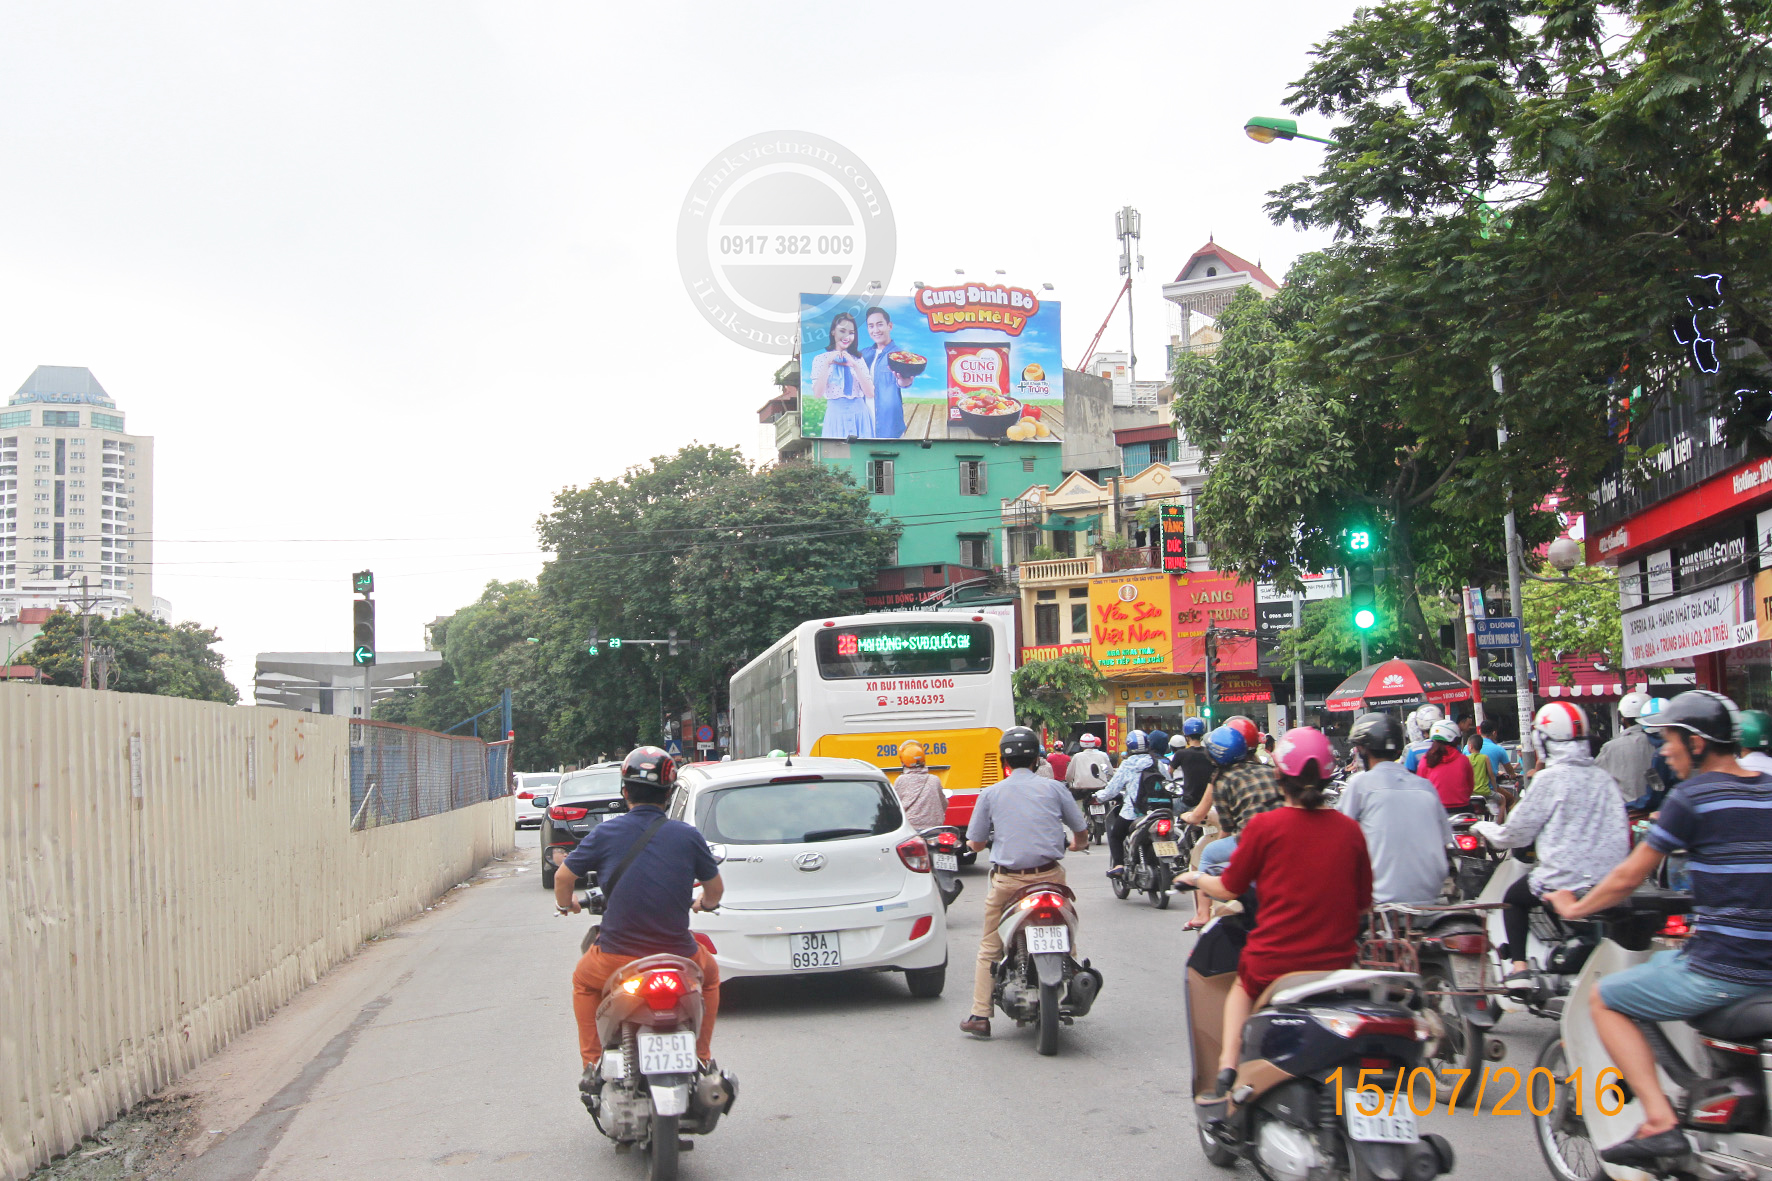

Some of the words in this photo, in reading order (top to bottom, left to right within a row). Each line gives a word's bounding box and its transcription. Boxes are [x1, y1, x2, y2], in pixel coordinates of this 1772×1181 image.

[922, 289, 966, 307] Cung
[967, 286, 1008, 305] Đình
[1011, 290, 1033, 309] Bò
[978, 310, 1001, 323] Mê
[960, 360, 994, 371] CUNG
[1674, 431, 1692, 470] kiện
[1733, 468, 1759, 494] Hotline:
[1163, 518, 1184, 533] VÀNG
[1351, 532, 1369, 550] 23
[1164, 557, 1187, 569] TRUNG
[1680, 548, 1713, 576] SAMSUNG
[1713, 537, 1745, 565] Galaxy
[1650, 562, 1671, 578] NOKIA
[895, 591, 915, 606] ĐỘNG
[1191, 587, 1233, 604] VÀNG
[1097, 600, 1128, 623] Yến
[1207, 607, 1249, 621] TRUNG
[1489, 621, 1516, 629] ĐƯỜNG
[1630, 620, 1647, 635] XPERIA
[1648, 616, 1655, 629] XA
[1659, 608, 1674, 627] HÀNG
[1094, 624, 1124, 645] Việt
[1128, 623, 1166, 643] Nam
[1495, 633, 1510, 645] PHONG
[1510, 631, 1519, 644] SẮC
[1691, 631, 1702, 647] LOA
[1704, 628, 1712, 643] 20
[1737, 625, 1753, 643] SONY
[609, 638, 621, 648] 23
[838, 635, 858, 655] 26
[858, 639, 875, 651] MAI
[1022, 648, 1058, 665] PHOTO
[866, 682, 878, 691] XN
[880, 681, 896, 691] BUS
[931, 678, 954, 689] LONG
[1227, 679, 1262, 688] TRUNG
[897, 694, 945, 706] 38436393
[876, 745, 898, 758] 29B
[1033, 927, 1062, 938] 30-H6
[802, 934, 828, 950] 30A
[1034, 939, 1063, 951] 6348
[793, 950, 839, 968] 693.22
[648, 1036, 686, 1053] 29-G1
[644, 1052, 693, 1071] 217.55
